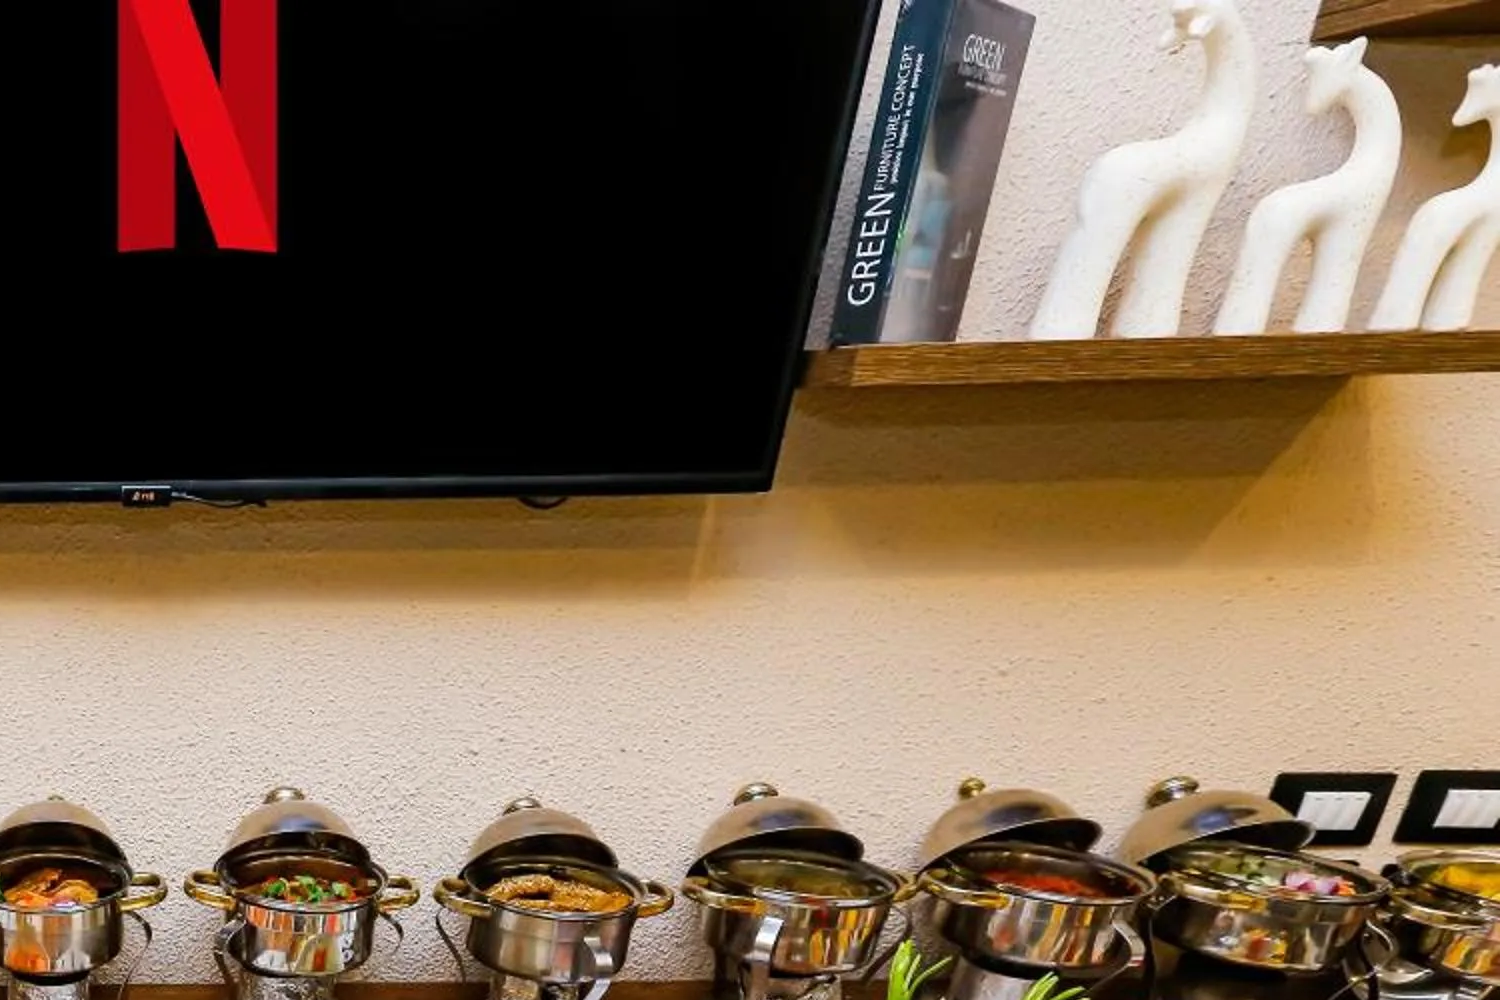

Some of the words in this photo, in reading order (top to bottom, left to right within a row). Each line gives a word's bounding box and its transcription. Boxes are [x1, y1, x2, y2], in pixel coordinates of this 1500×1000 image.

[117, 0, 278, 252] N
[847, 191, 895, 305] GREEN
[873, 114, 900, 191] FURNITURE
[891, 44, 916, 111] CONCEPT
